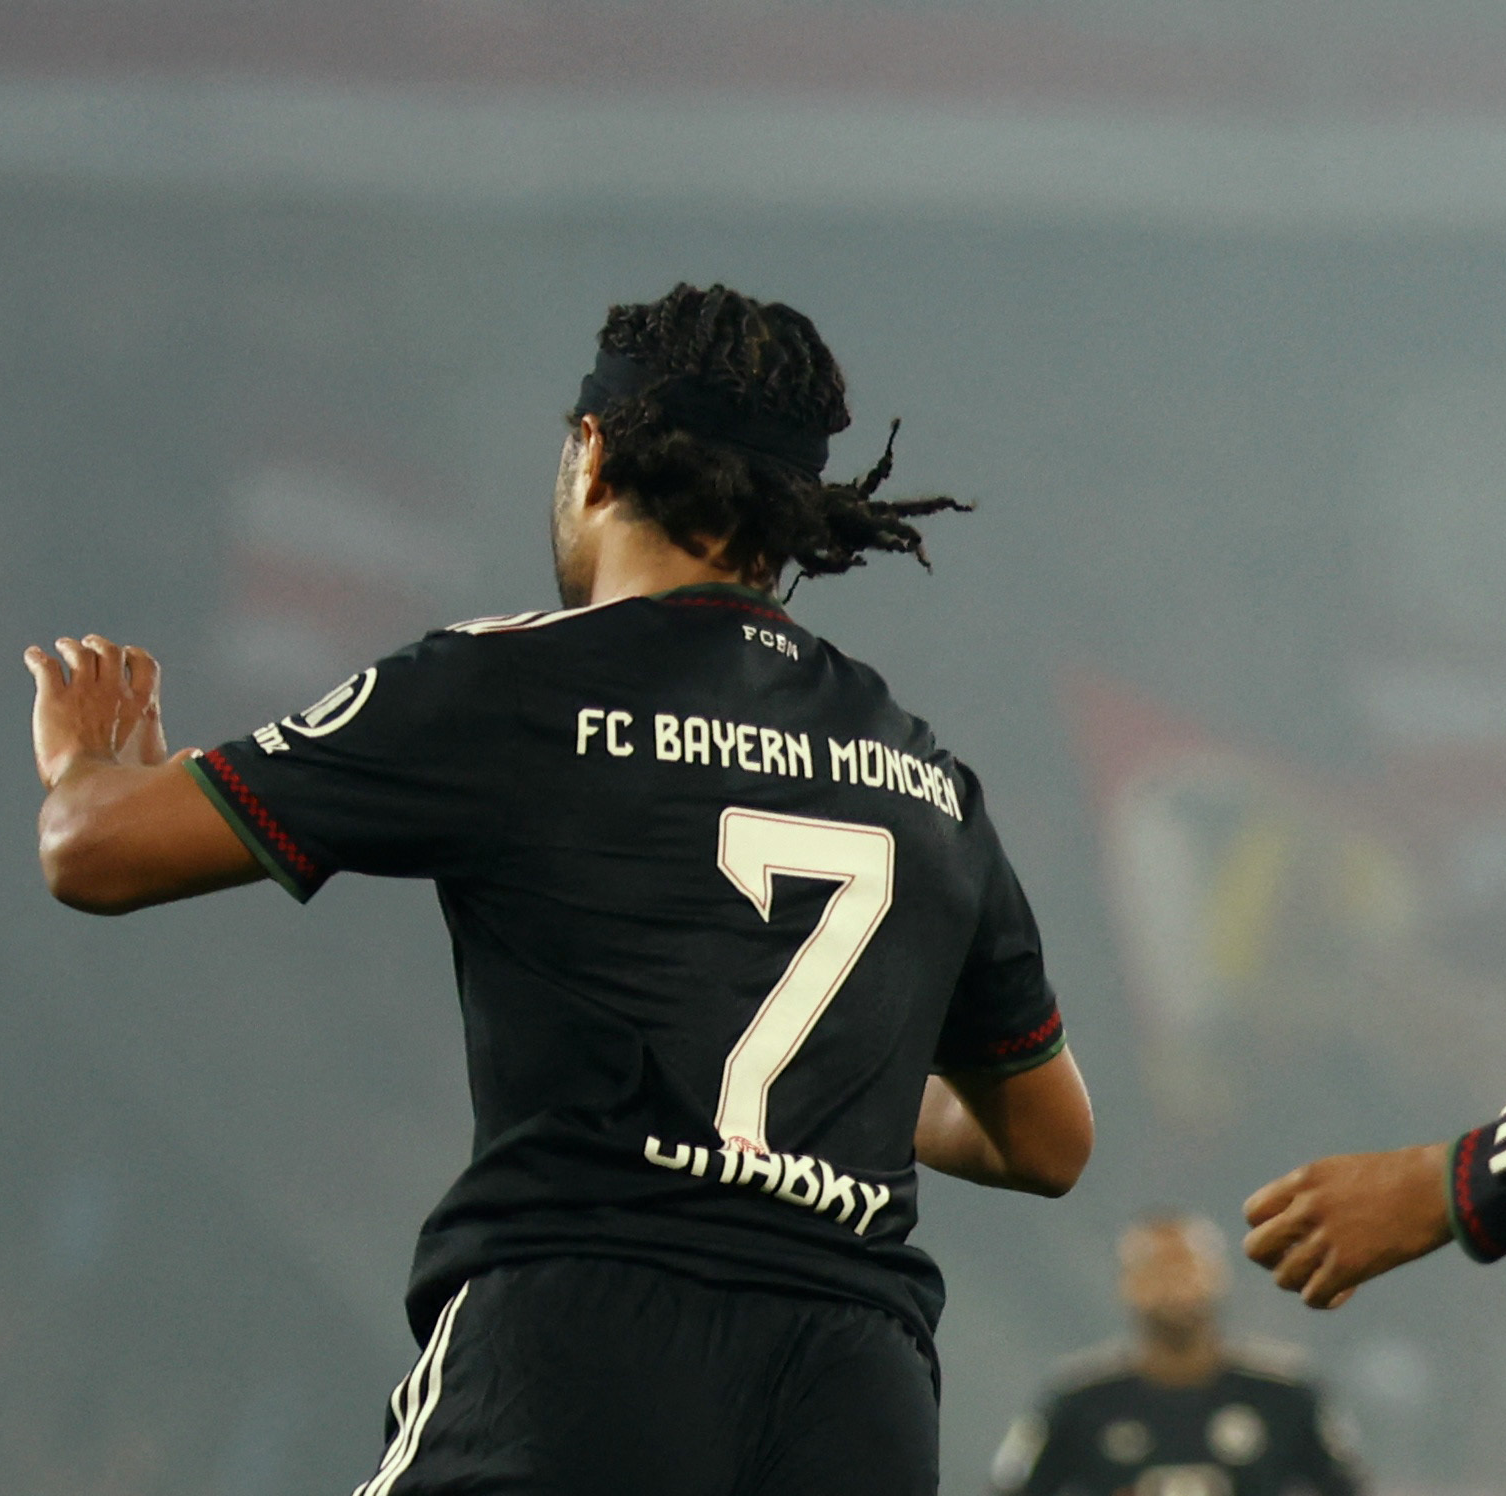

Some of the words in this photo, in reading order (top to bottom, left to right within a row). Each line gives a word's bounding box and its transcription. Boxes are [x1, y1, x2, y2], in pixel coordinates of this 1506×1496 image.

[741, 624, 799, 662] FCBM
[576, 708, 634, 757] FC
[654, 713, 814, 779] BAYERN
[828, 736, 963, 822] MÜNCHEN
[716, 805, 895, 1156] 7
